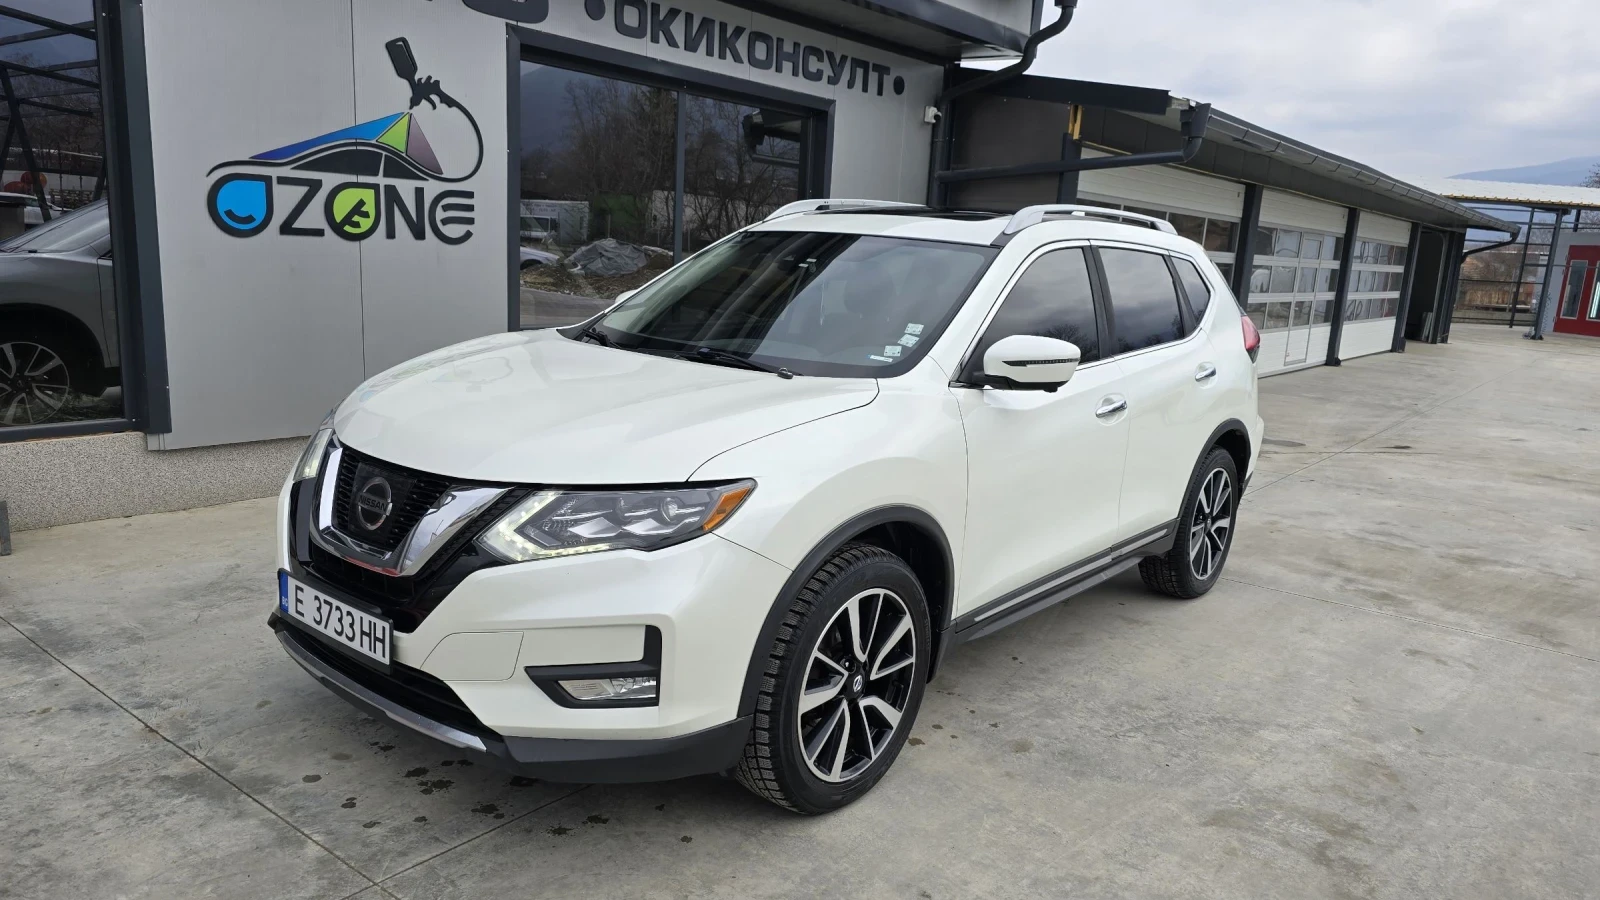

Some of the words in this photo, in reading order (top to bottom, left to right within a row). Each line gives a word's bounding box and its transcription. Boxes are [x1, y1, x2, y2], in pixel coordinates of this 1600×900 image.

[206, 172, 476, 246] OZONE
[358, 494, 388, 512] NISSAN
[294, 584, 305, 618] E
[312, 594, 356, 643] 3733
[359, 615, 386, 659] HH
